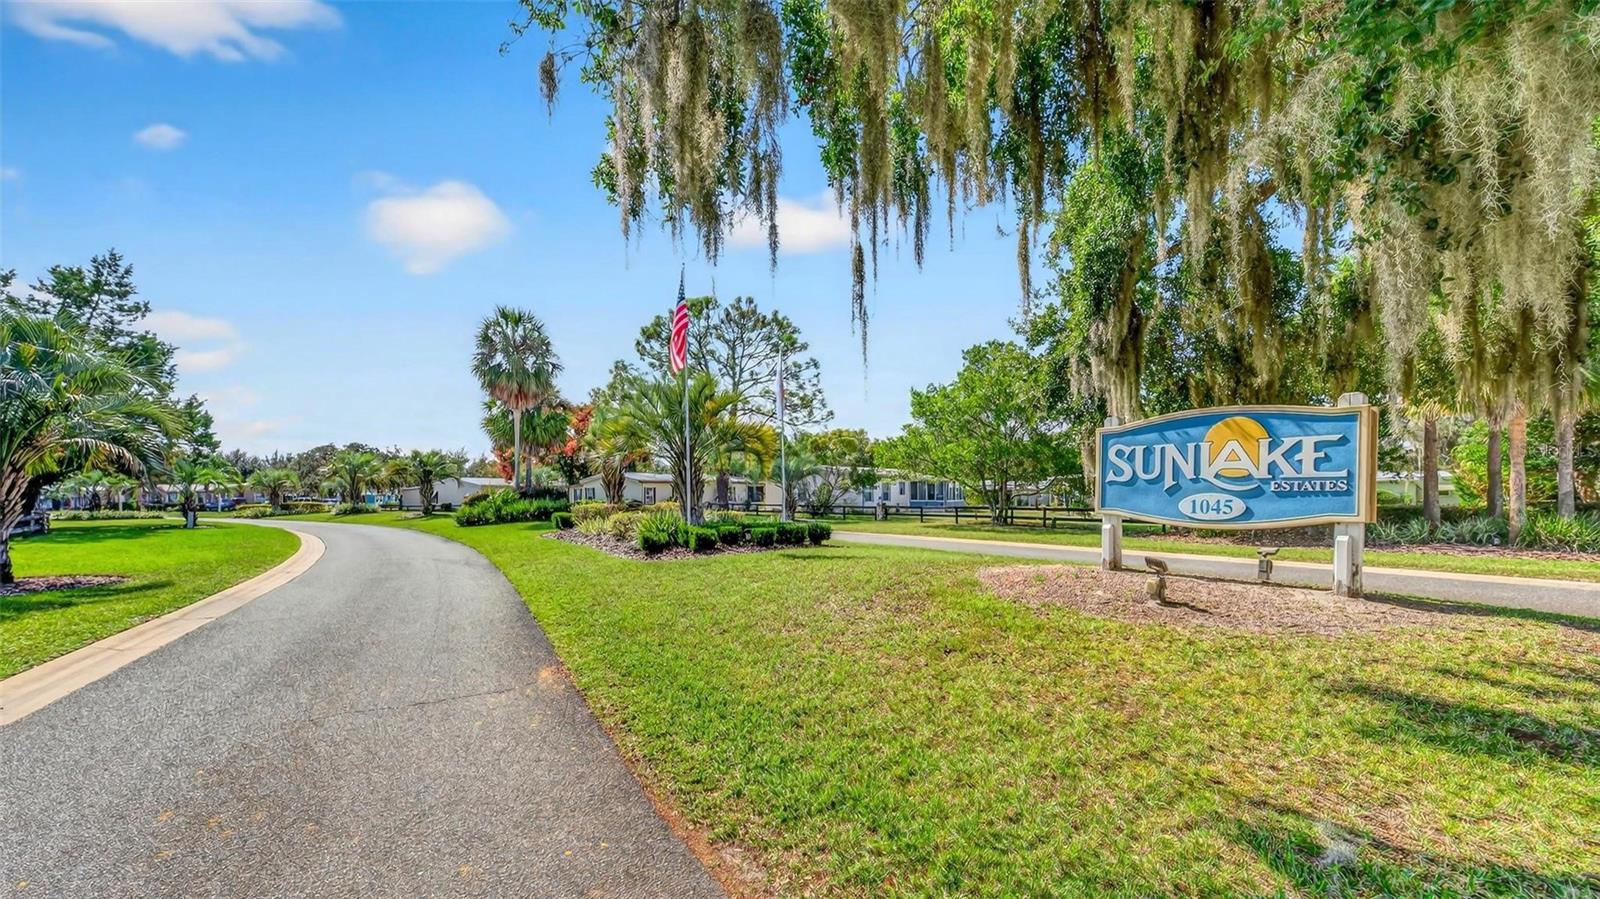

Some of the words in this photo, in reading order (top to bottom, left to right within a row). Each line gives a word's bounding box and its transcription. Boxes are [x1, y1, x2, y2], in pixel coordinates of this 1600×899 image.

[1105, 434, 1348, 492] SUNLAKE
[1270, 480, 1348, 492] ESTATES
[1189, 498, 1234, 515] 1045
